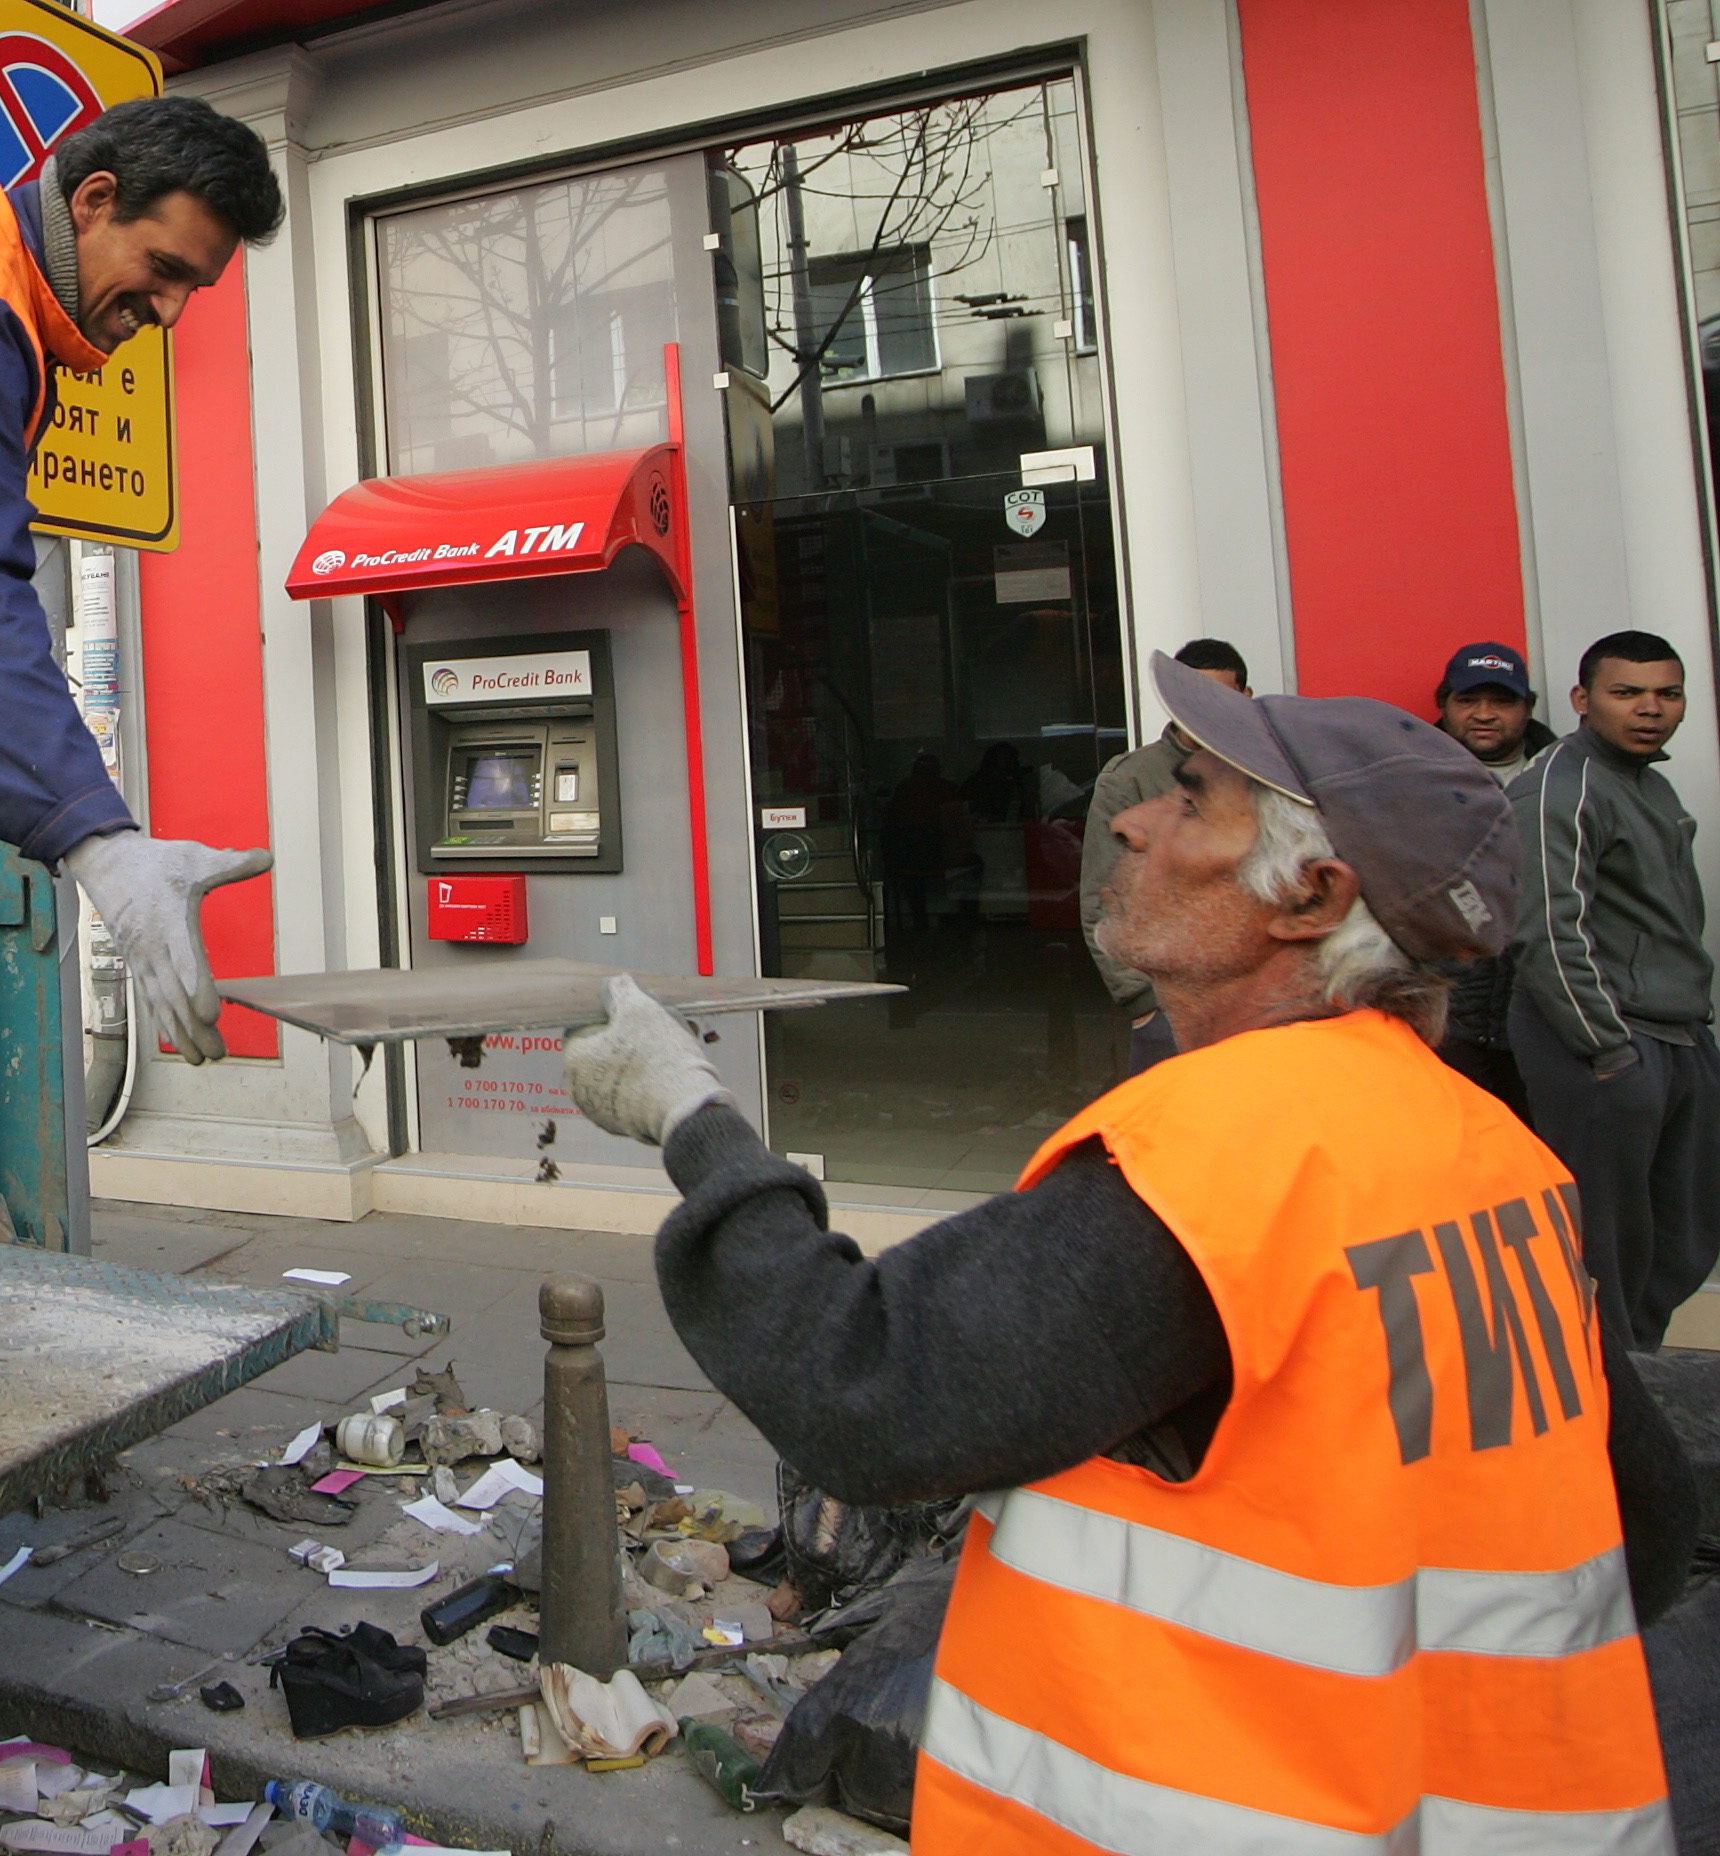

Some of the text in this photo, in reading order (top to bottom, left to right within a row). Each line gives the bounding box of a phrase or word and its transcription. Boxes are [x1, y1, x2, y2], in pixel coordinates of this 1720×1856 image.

[122, 368, 135, 394] е
[117, 416, 131, 444] и
[350, 522, 585, 569] ProCredit Bank ATM
[472, 669, 583, 690] ProCredit Bank
[464, 1079, 473, 1091] 0
[476, 1080, 498, 1092] 700
[502, 1081, 524, 1093] 170
[528, 1083, 543, 1094] 70
[458, 1098, 480, 1109] 700
[484, 1099, 506, 1110] 170
[509, 1100, 525, 1111] 70
